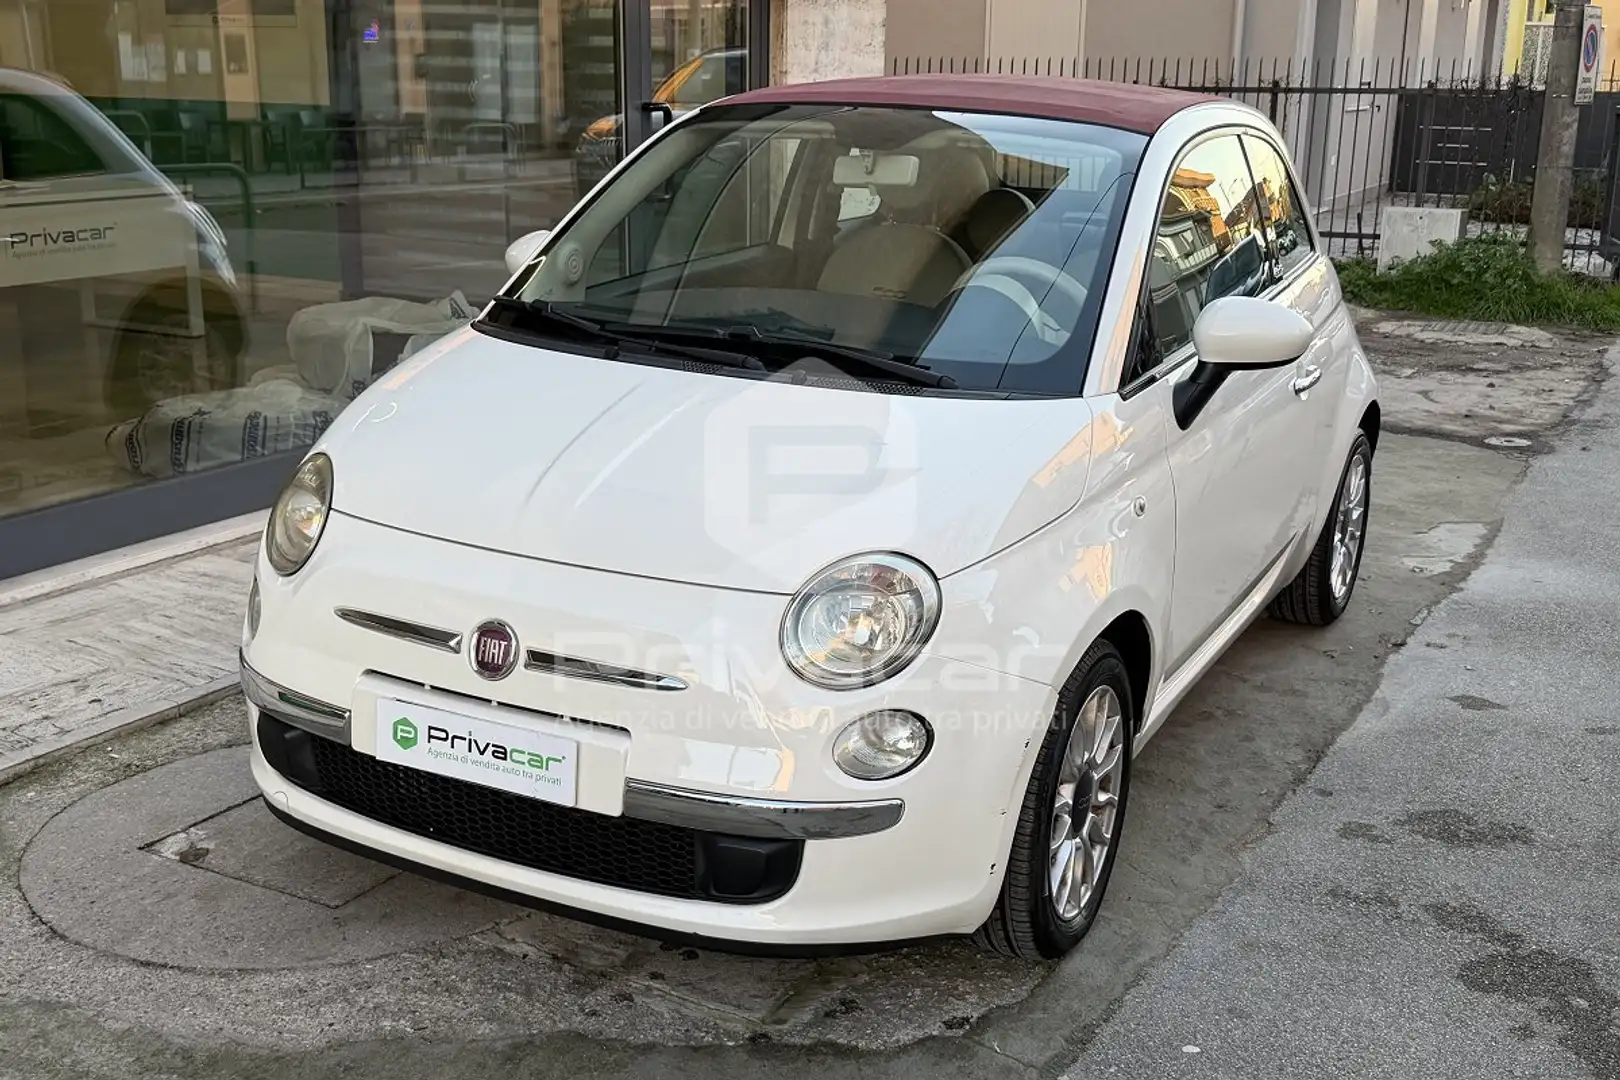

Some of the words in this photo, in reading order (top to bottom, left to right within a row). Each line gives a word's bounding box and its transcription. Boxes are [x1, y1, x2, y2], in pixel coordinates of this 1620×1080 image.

[9, 227, 115, 250] Privacar
[478, 636, 508, 665] FIAT
[427, 725, 563, 771] Privacar
[427, 746, 460, 764] Agenzia
[460, 756, 469, 765] di
[469, 757, 501, 772] vendita
[501, 766, 521, 777] auto
[522, 770, 533, 780] tra
[534, 774, 562, 787] privati
